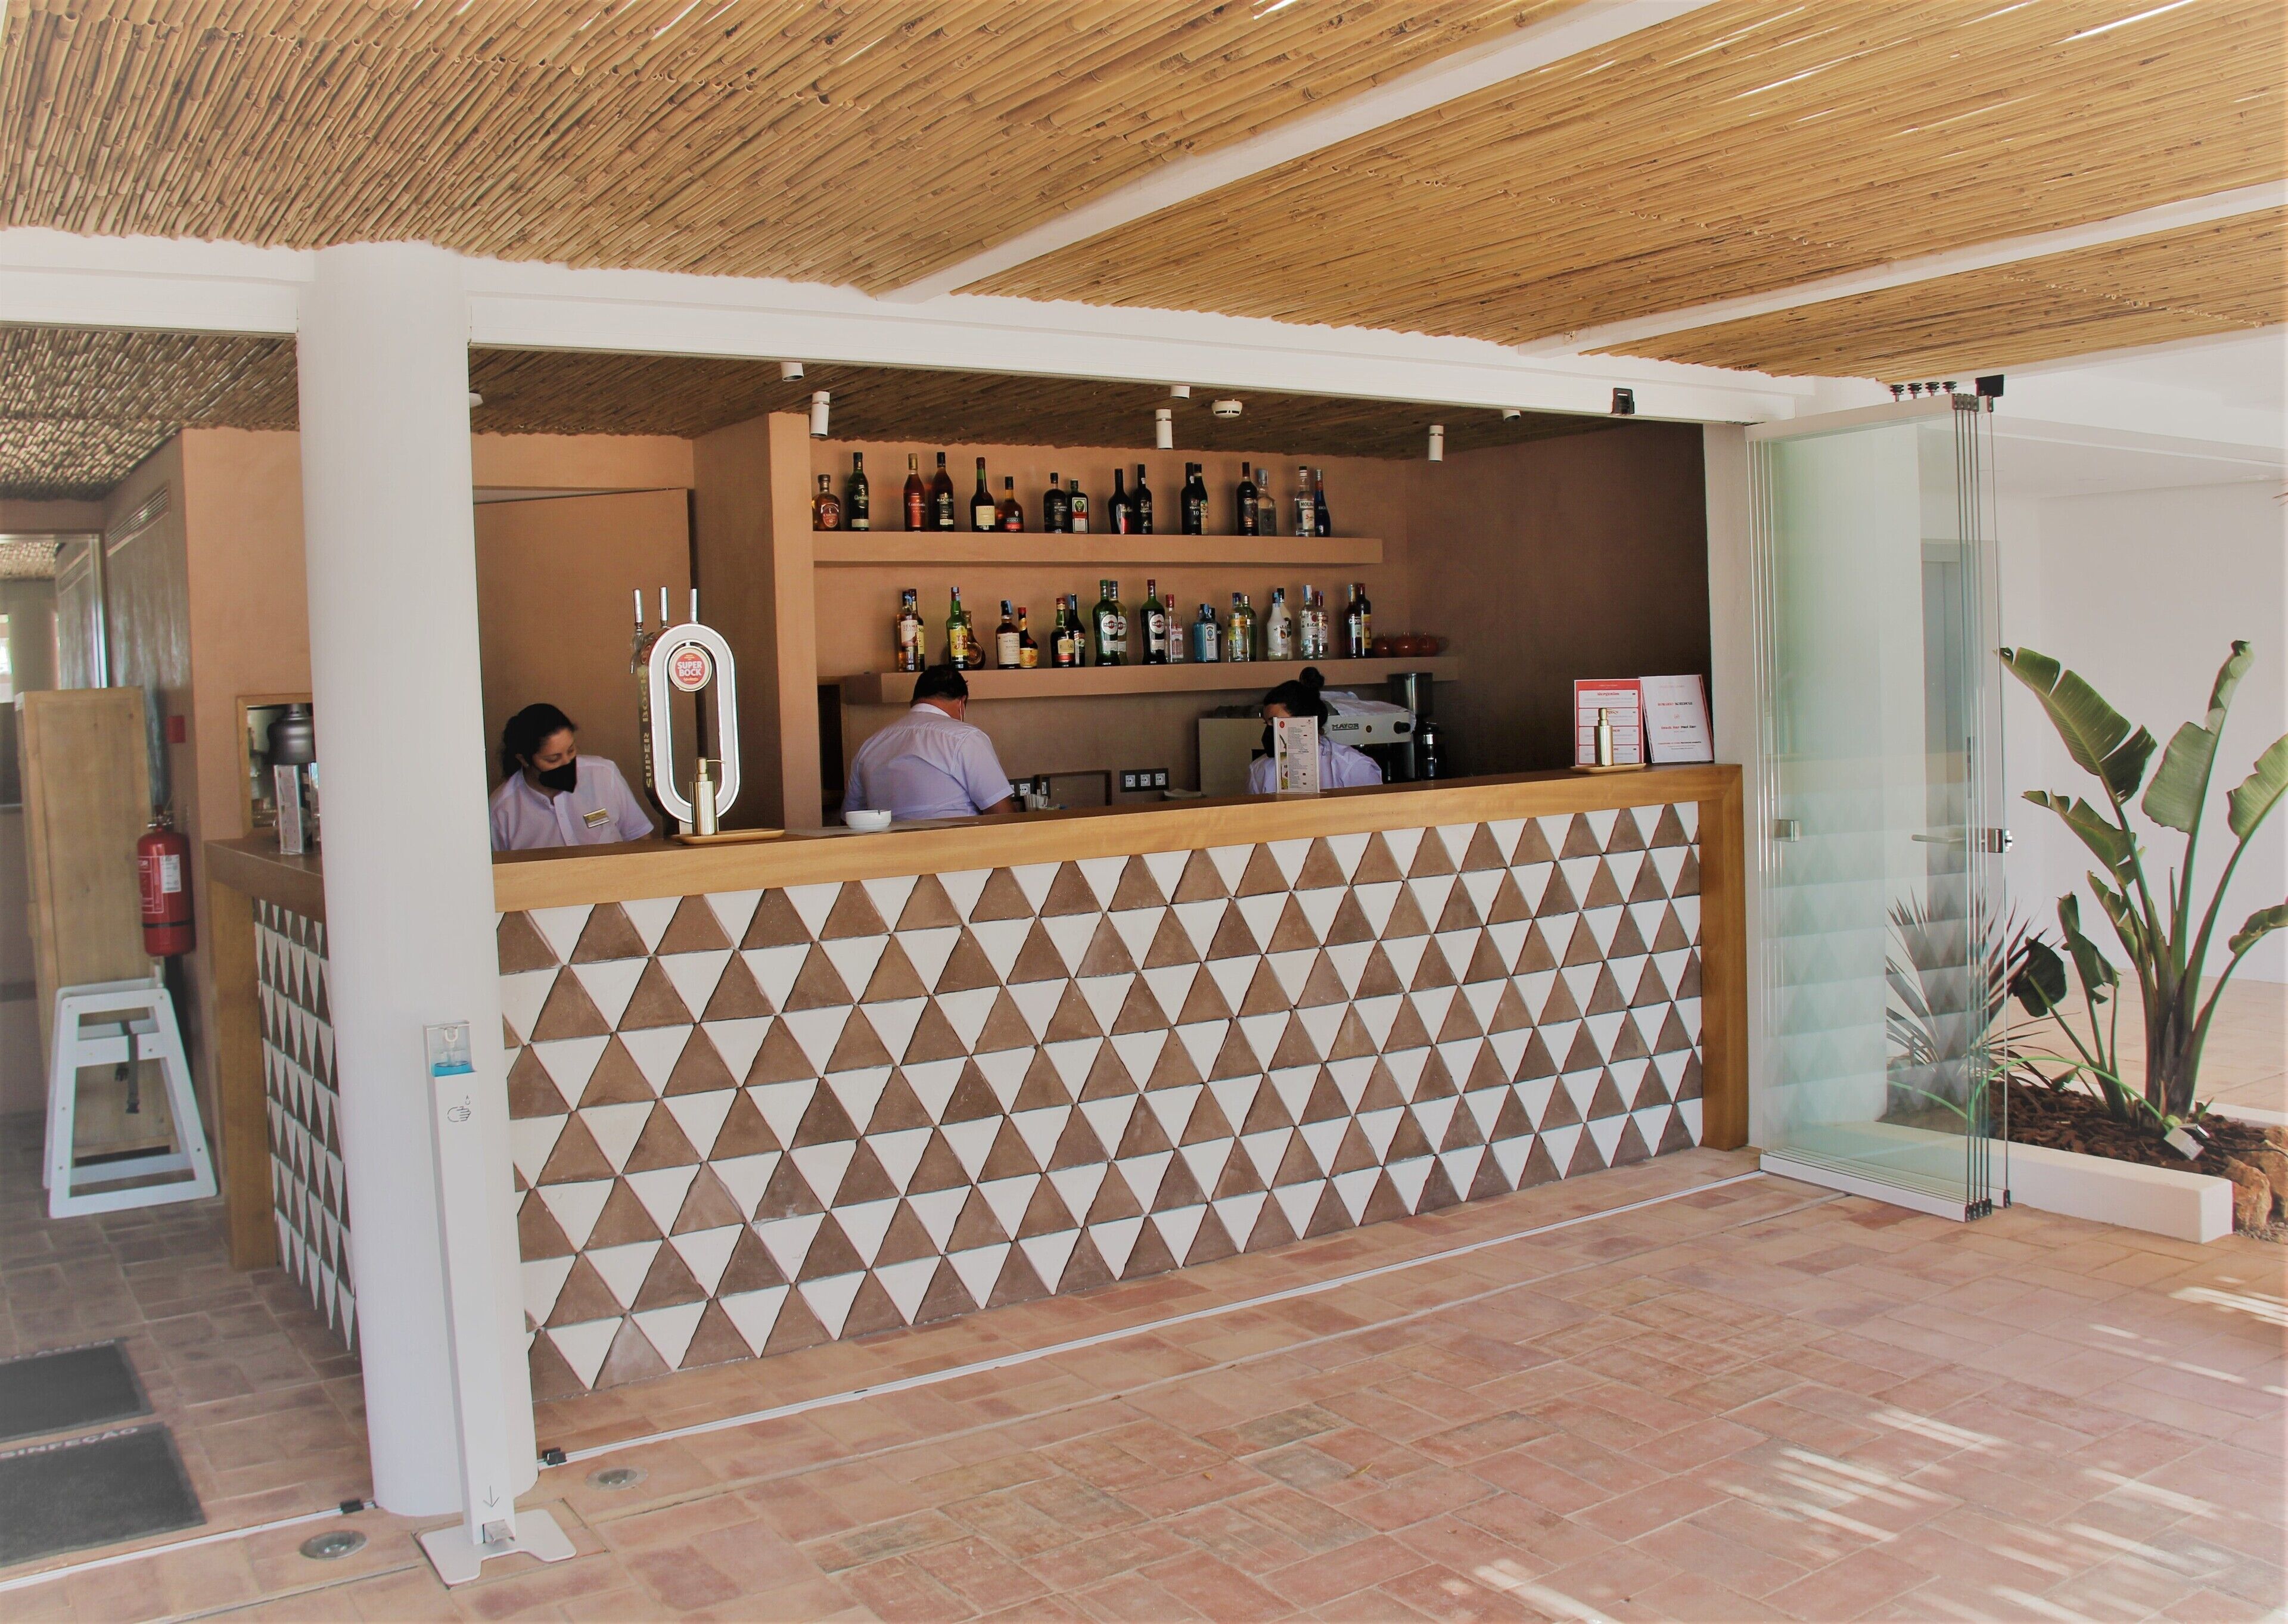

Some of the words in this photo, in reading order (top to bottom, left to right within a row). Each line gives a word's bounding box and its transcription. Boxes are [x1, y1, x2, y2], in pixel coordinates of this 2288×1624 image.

[677, 661, 702, 669] SUPER
[679, 668, 702, 677] BOCK
[0, 1427, 138, 1459] SINFEÇÃO
